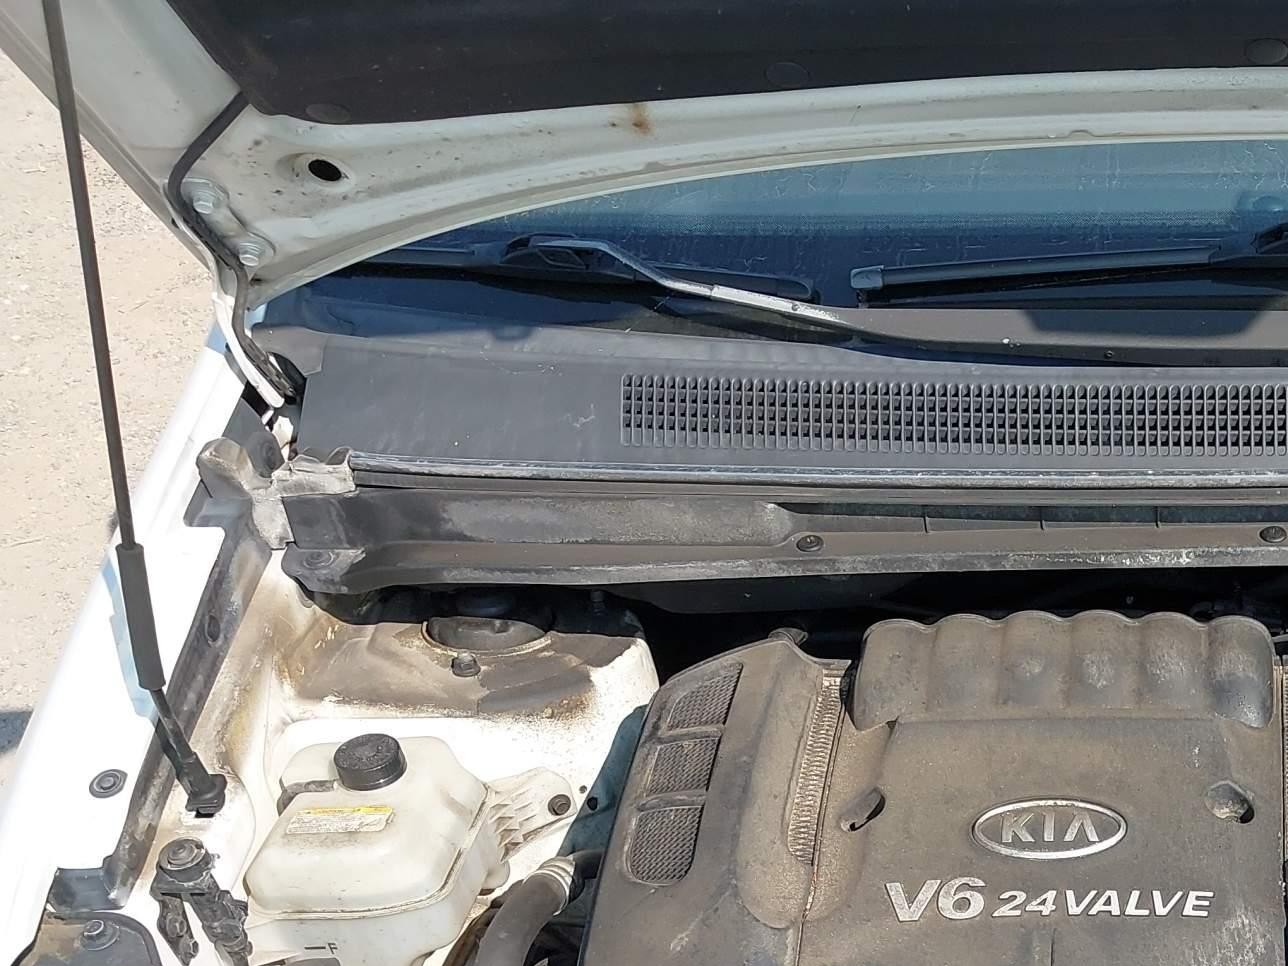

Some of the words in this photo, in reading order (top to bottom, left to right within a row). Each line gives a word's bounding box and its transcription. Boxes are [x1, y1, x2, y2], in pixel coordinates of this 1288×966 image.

[1001, 812, 1100, 842] KIA
[885, 877, 986, 922] V6
[327, 942, 338, 955] F
